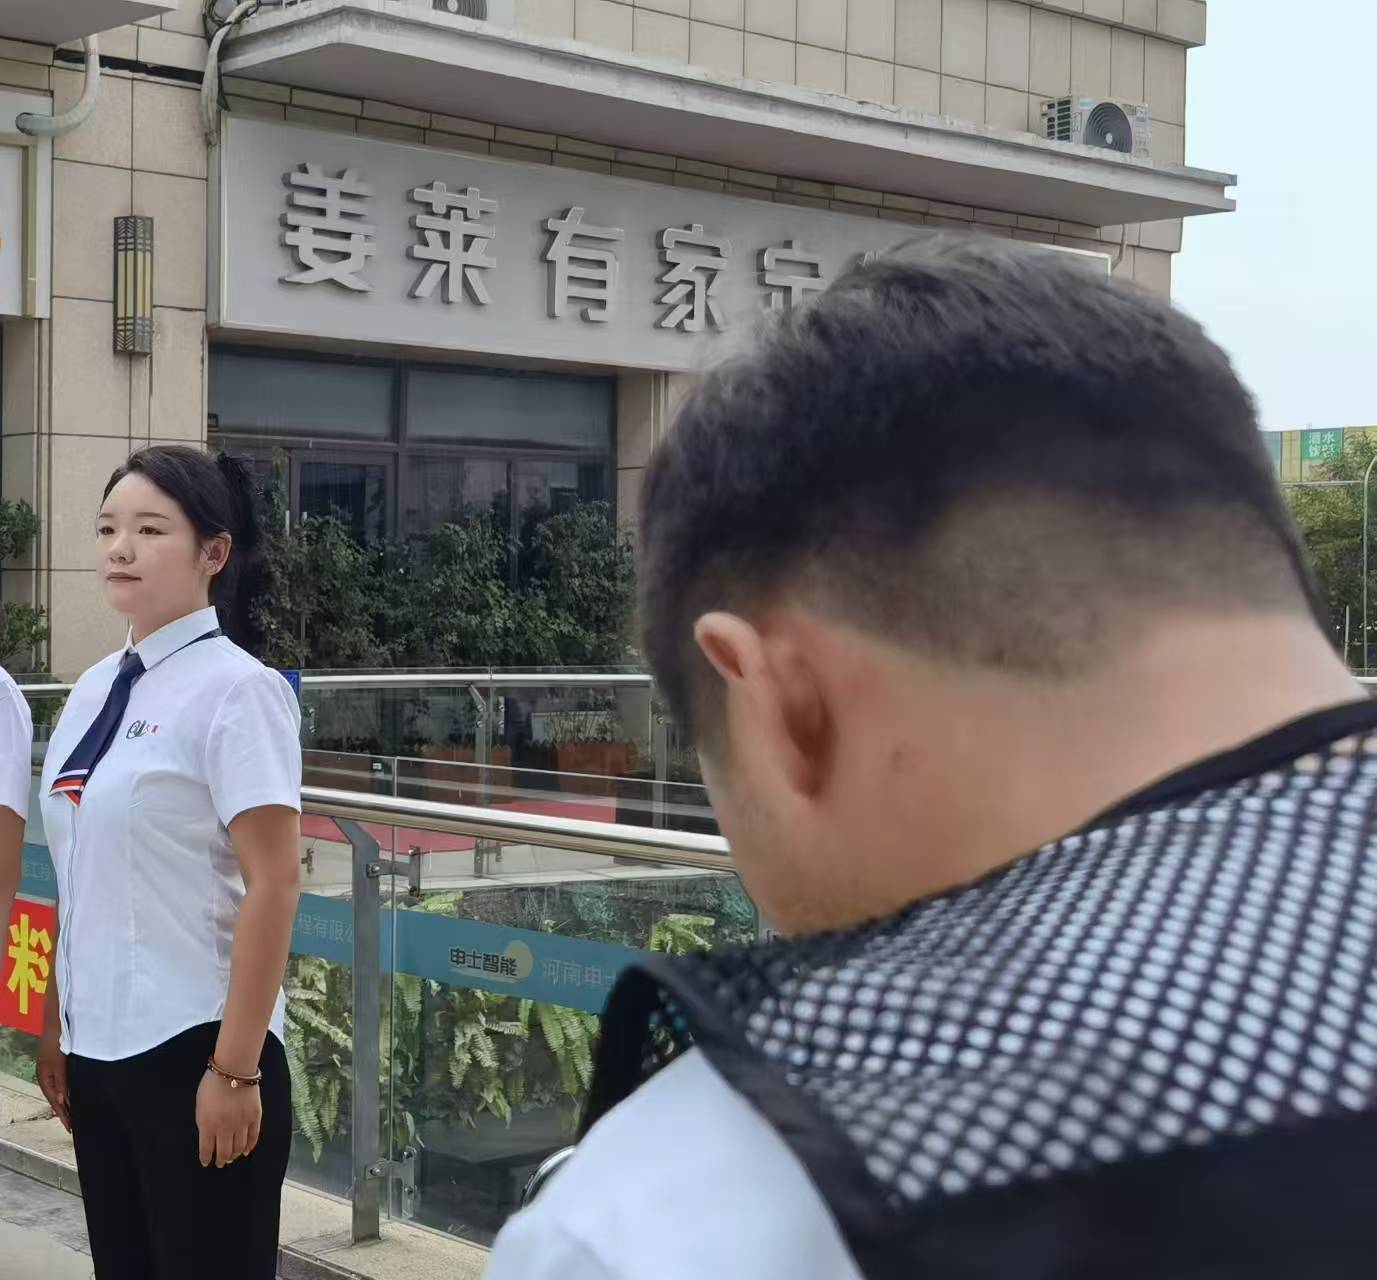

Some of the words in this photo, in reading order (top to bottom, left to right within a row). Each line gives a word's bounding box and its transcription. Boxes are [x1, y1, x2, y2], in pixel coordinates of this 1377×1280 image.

[279, 161, 881, 333] 姜莱有家定
